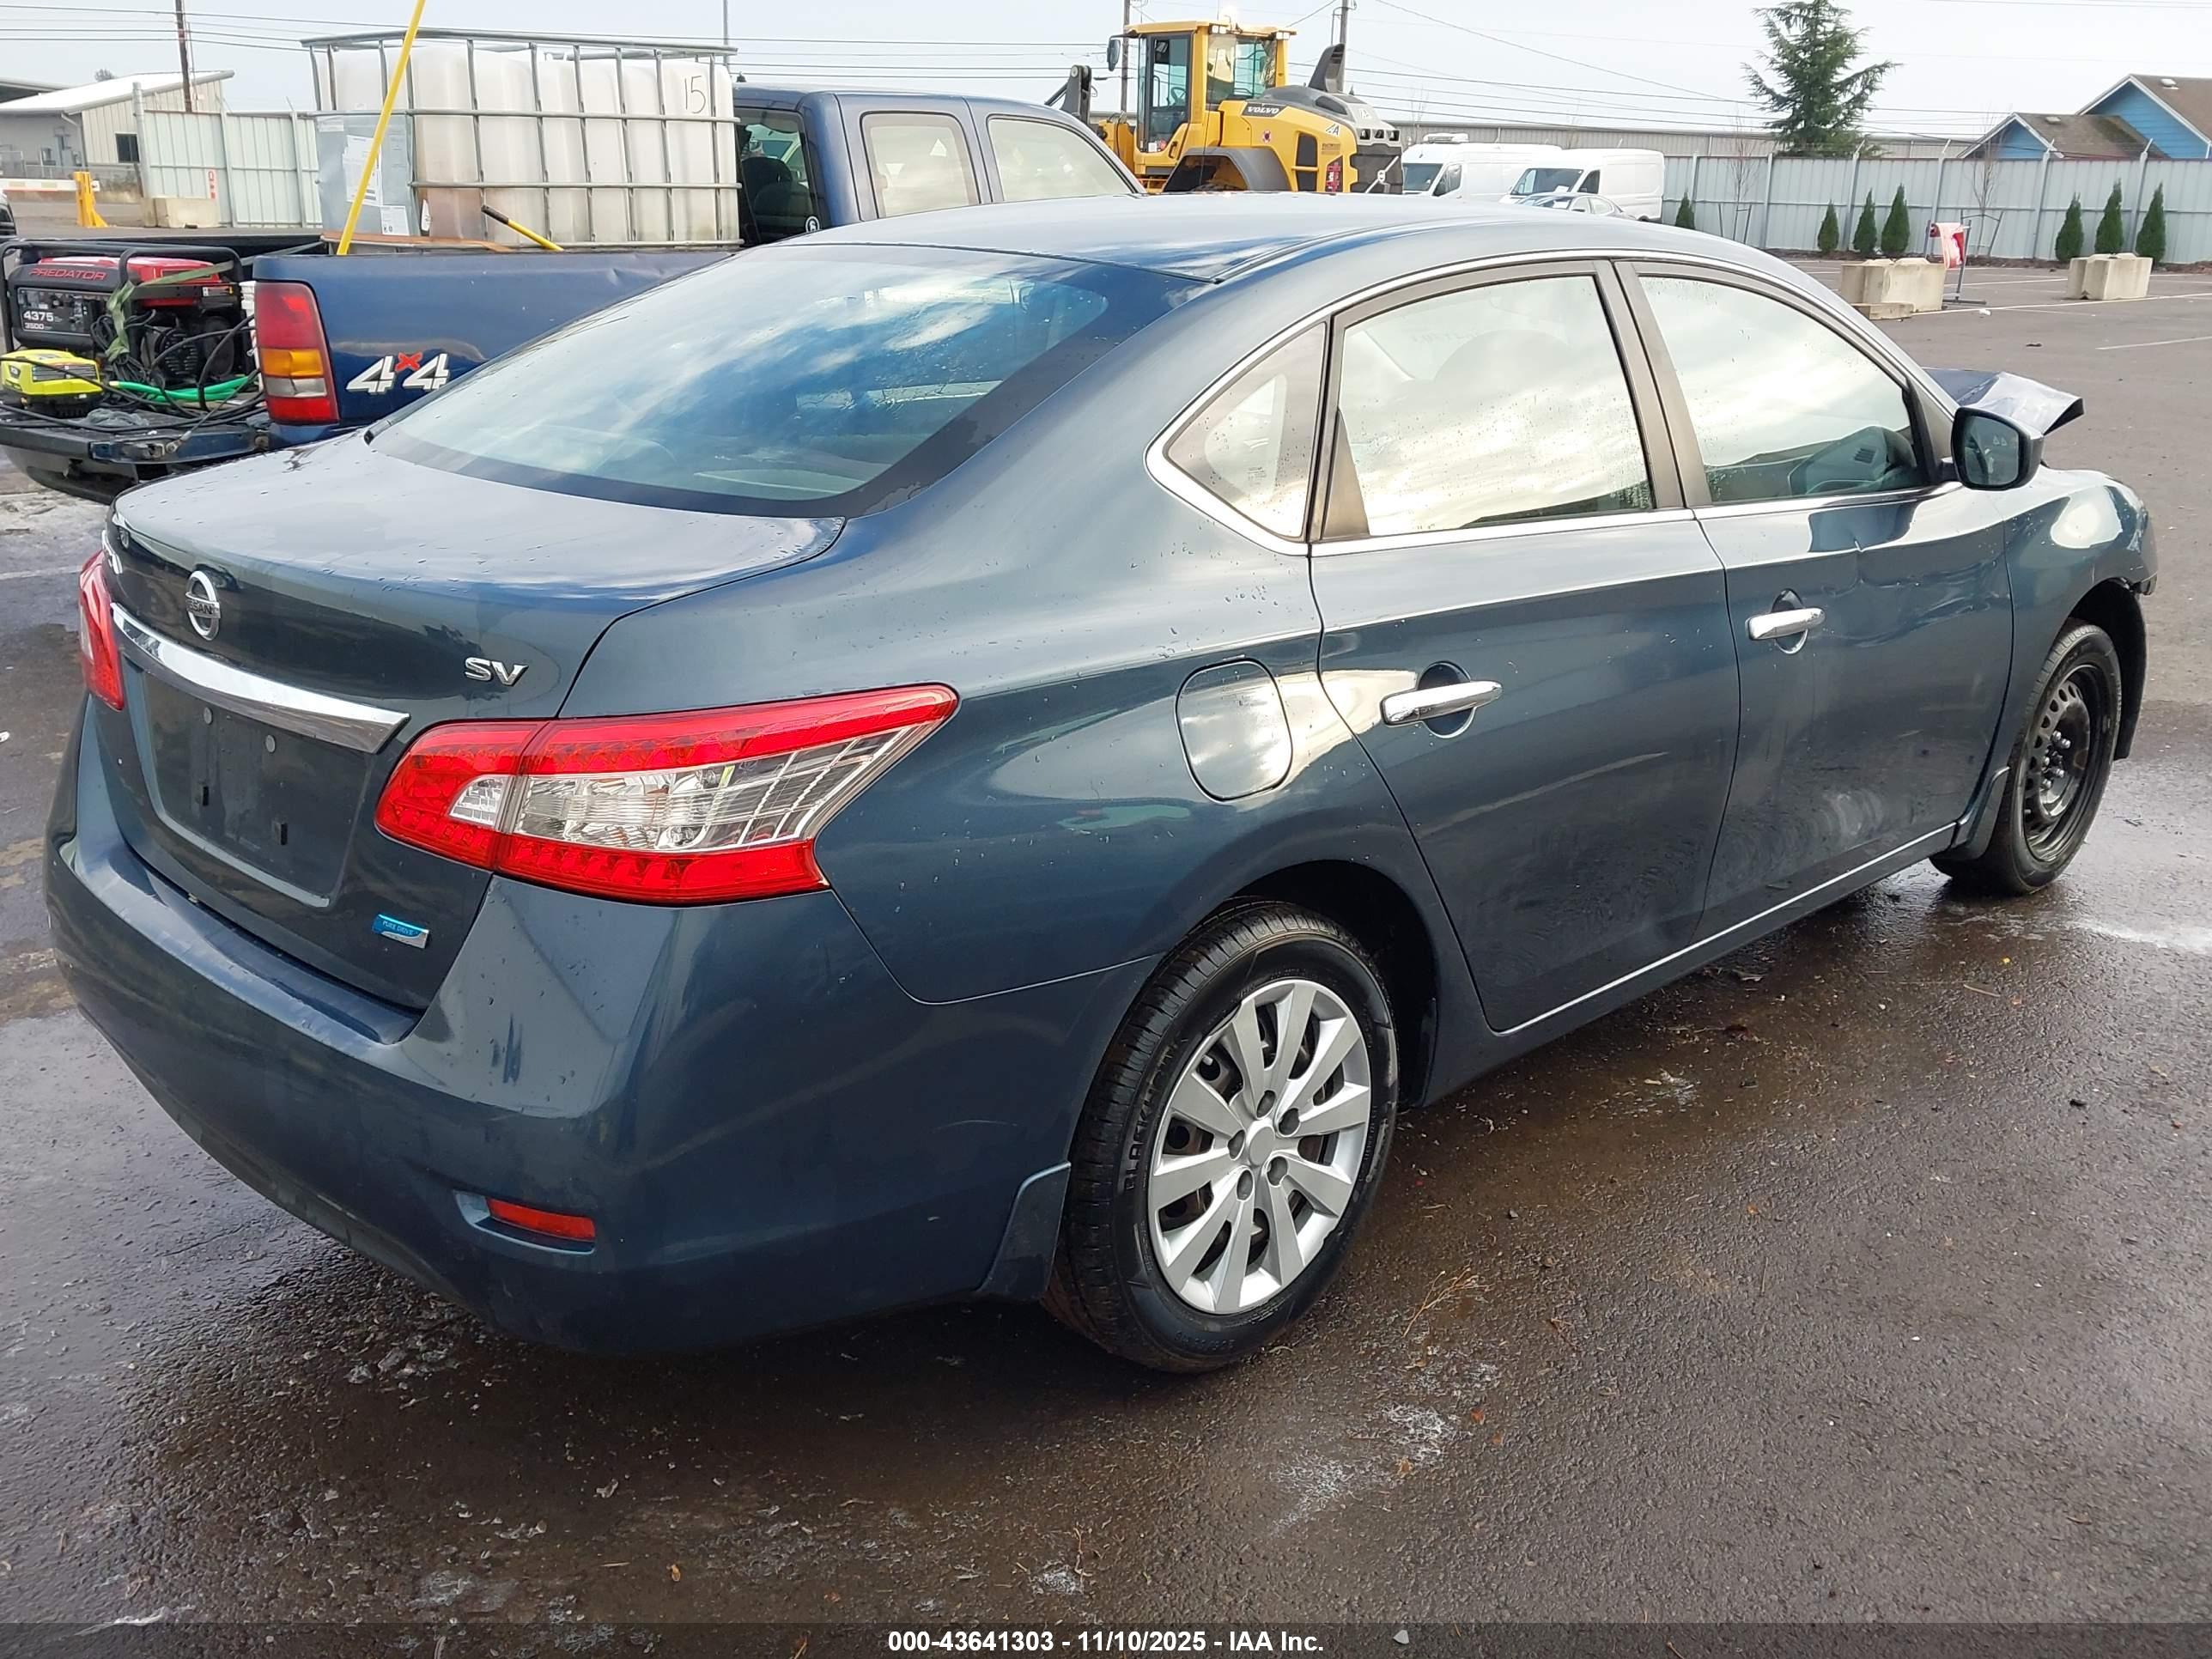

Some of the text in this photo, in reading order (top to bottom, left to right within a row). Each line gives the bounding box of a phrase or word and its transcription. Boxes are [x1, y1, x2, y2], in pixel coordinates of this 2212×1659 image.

[684, 75, 707, 114] 15
[1248, 106, 1280, 114] VOLVO
[29, 268, 106, 280] PREDATOR
[23, 310, 54, 322] 4375
[465, 657, 529, 686] SV
